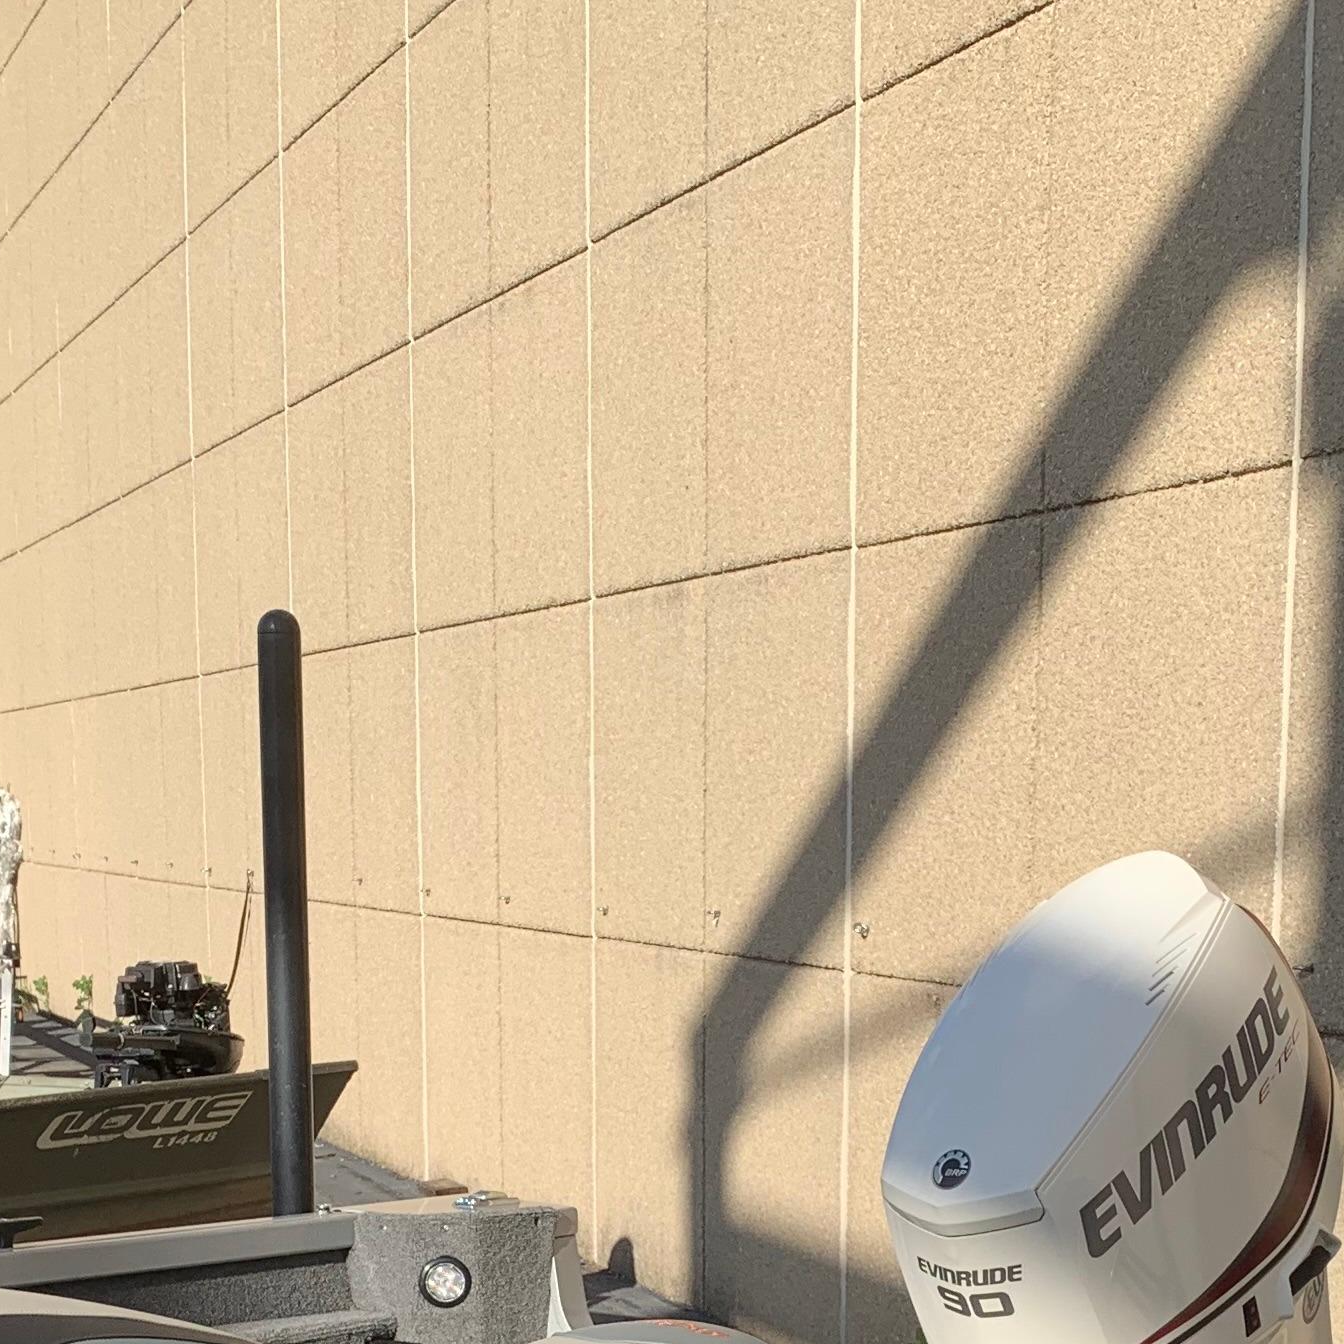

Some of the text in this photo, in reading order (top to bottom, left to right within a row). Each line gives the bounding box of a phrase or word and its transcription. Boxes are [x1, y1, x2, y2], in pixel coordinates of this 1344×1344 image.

[36, 1091, 254, 1149] LOWE
[1079, 964, 1290, 1258] EVINRUDE
[153, 1131, 218, 1149] L1448
[917, 1255, 1023, 1287] EVINRUDE
[937, 1285, 1015, 1318] 90
